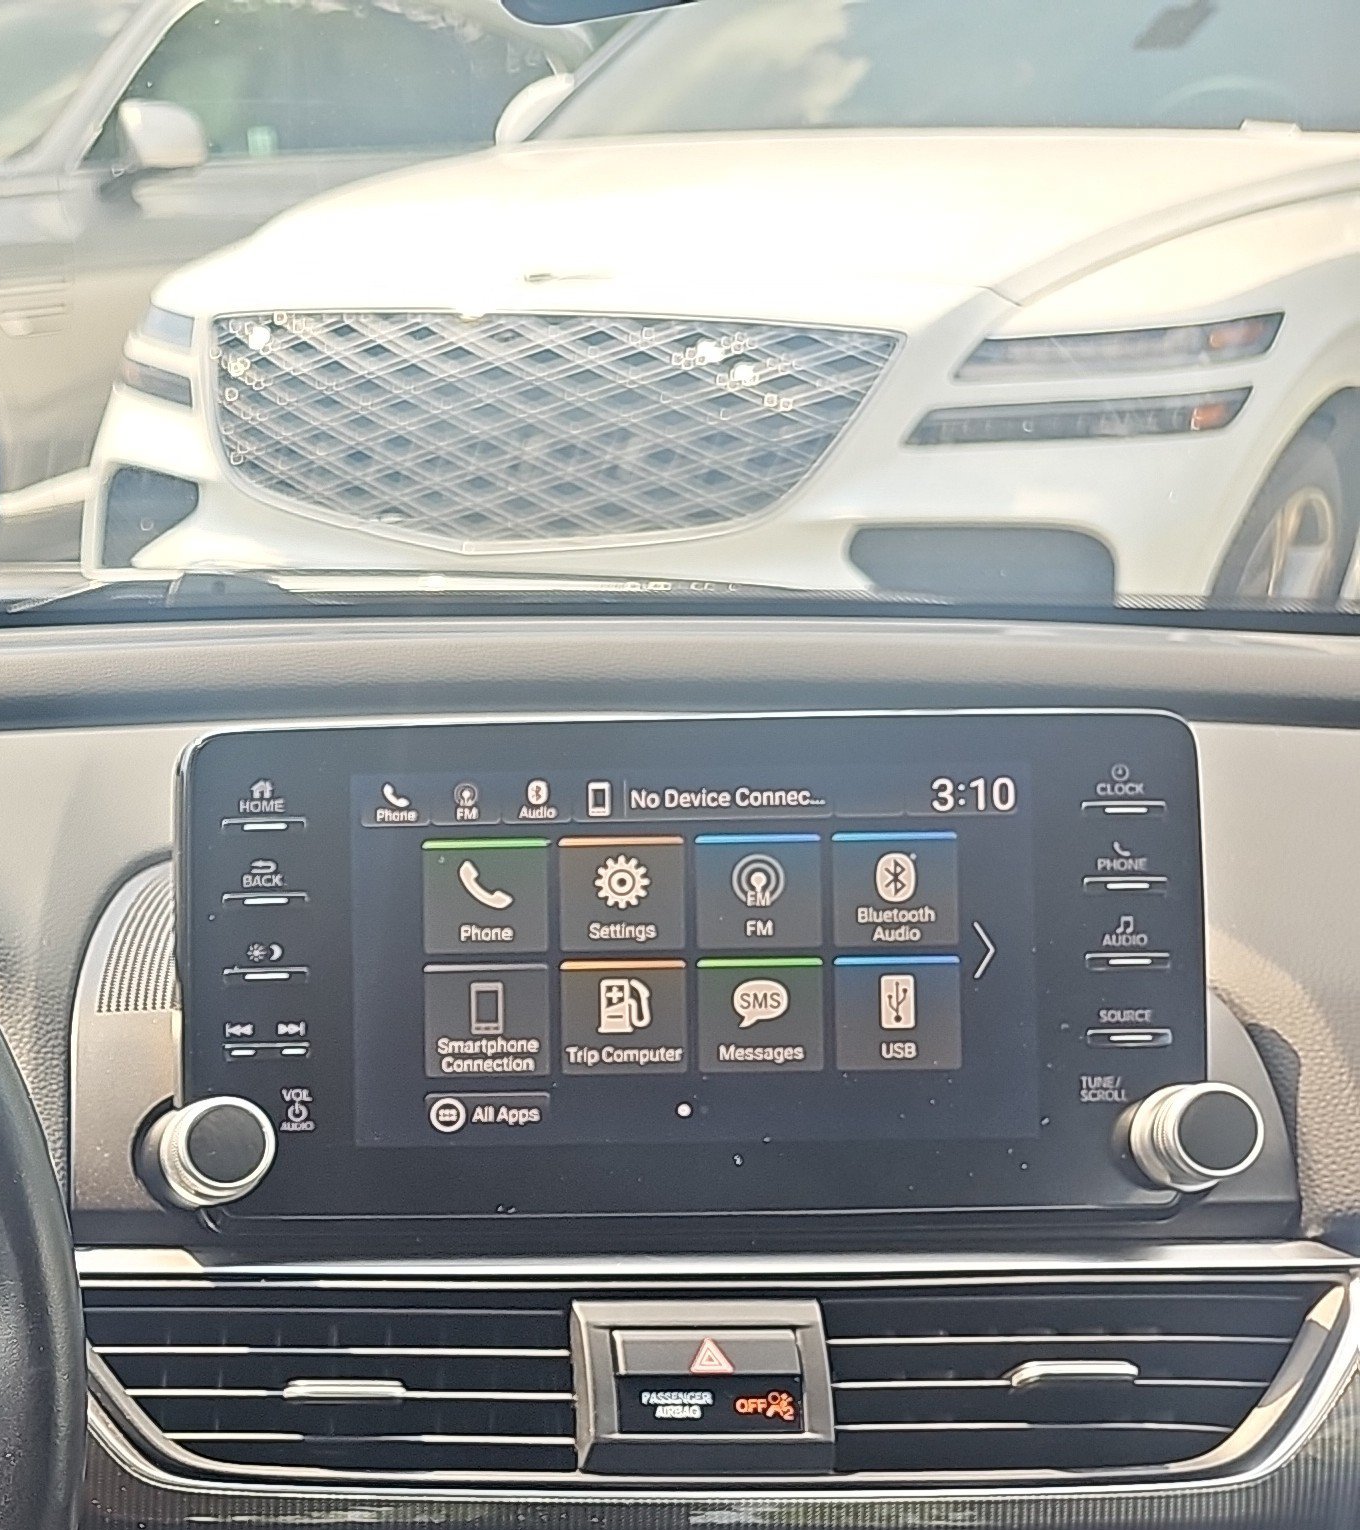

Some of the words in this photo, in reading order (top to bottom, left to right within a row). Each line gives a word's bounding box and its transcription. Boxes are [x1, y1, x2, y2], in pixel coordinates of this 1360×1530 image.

[931, 777, 1017, 813] 3:10
[1096, 783, 1144, 796] CLOCK
[239, 799, 285, 813] HOME
[631, 789, 660, 809] No
[665, 788, 731, 808] Device
[376, 809, 417, 823] Phone
[456, 807, 479, 820] FM
[519, 806, 557, 820] Audio
[1097, 858, 1148, 871] PHONE
[242, 873, 283, 888] BACK
[857, 907, 935, 925] Bluetooth
[460, 926, 514, 943] Phone
[589, 923, 657, 943] Settings
[746, 920, 774, 937] FM
[873, 926, 921, 943] Audio
[1102, 933, 1148, 947] AUDIO
[740, 992, 782, 1010] SMS
[1099, 1009, 1152, 1022] SOURCE
[437, 1038, 540, 1056] Smartphone
[718, 1044, 804, 1063] Messages
[881, 1042, 916, 1060] USB
[567, 1047, 599, 1065] Trip
[601, 1046, 683, 1064] Computer
[441, 1056, 535, 1073] Connection
[1080, 1075, 1122, 1088] TUNE/
[281, 1088, 313, 1102] VOL
[1080, 1089, 1128, 1102] SCROLL
[471, 1106, 495, 1122] All
[497, 1106, 540, 1126] Apps
[280, 1120, 315, 1131] AUDIO
[640, 1391, 714, 1406] PASSENGER
[654, 1405, 702, 1420] AIRBAG
[735, 1399, 767, 1414] OFF
